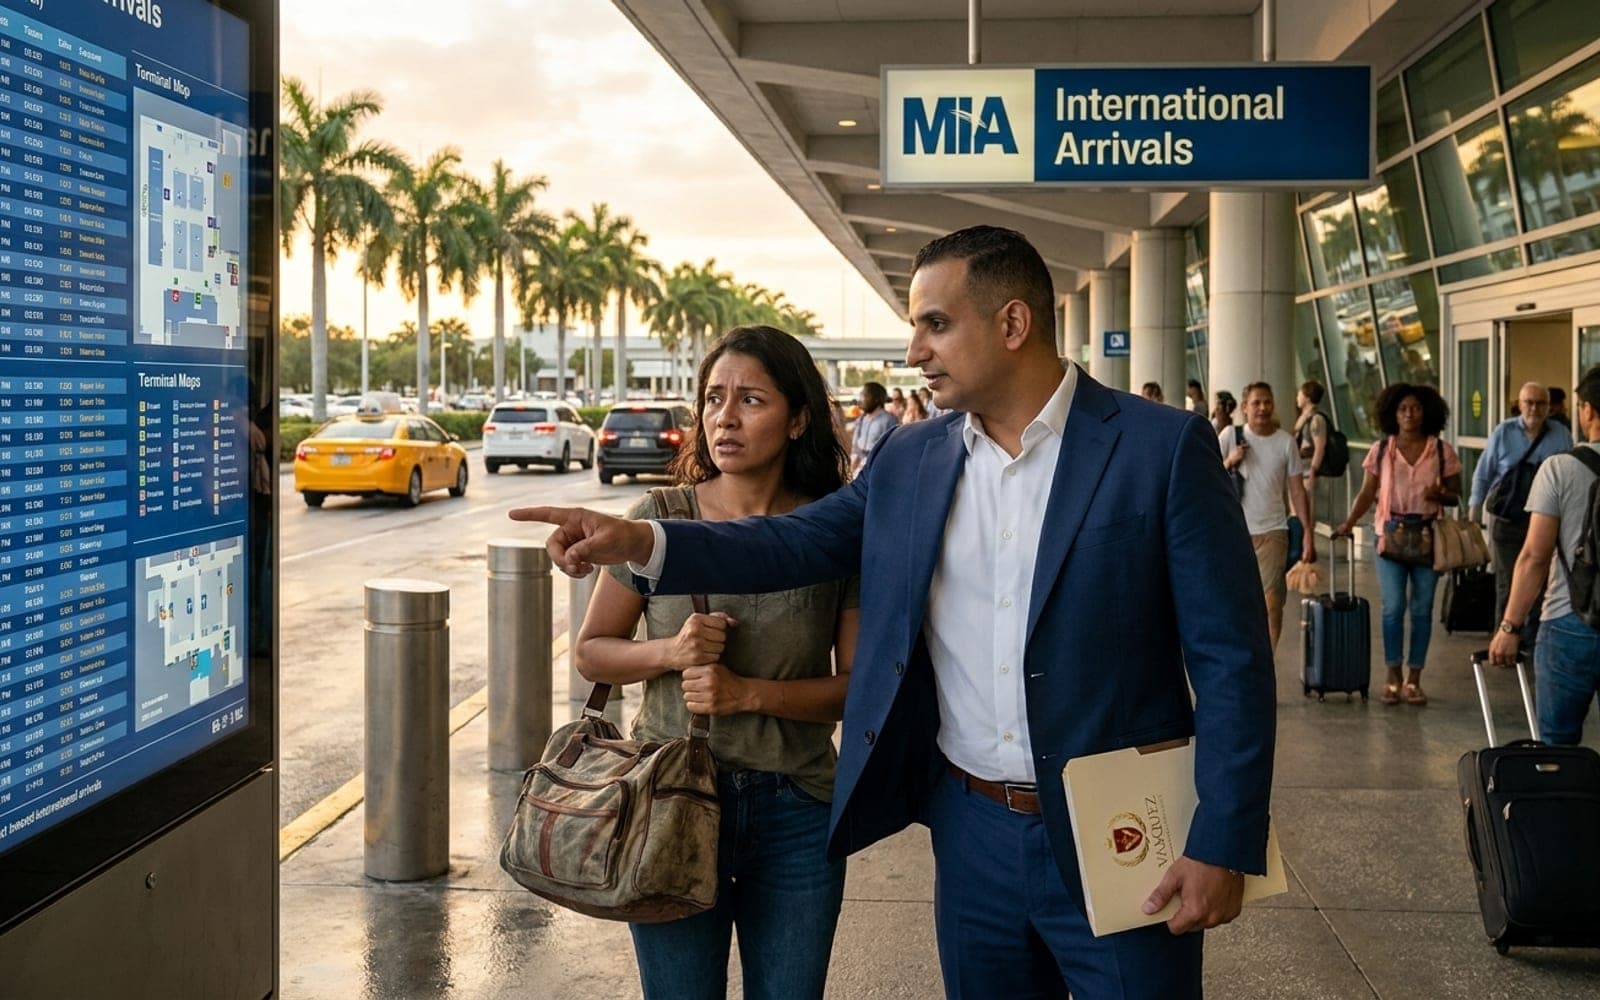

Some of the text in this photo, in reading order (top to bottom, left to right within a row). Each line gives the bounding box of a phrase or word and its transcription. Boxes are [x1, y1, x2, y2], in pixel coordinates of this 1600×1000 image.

[1056, 85, 1284, 121] International
[902, 96, 1019, 155] MIA
[1054, 131, 1194, 166] Arrivals
